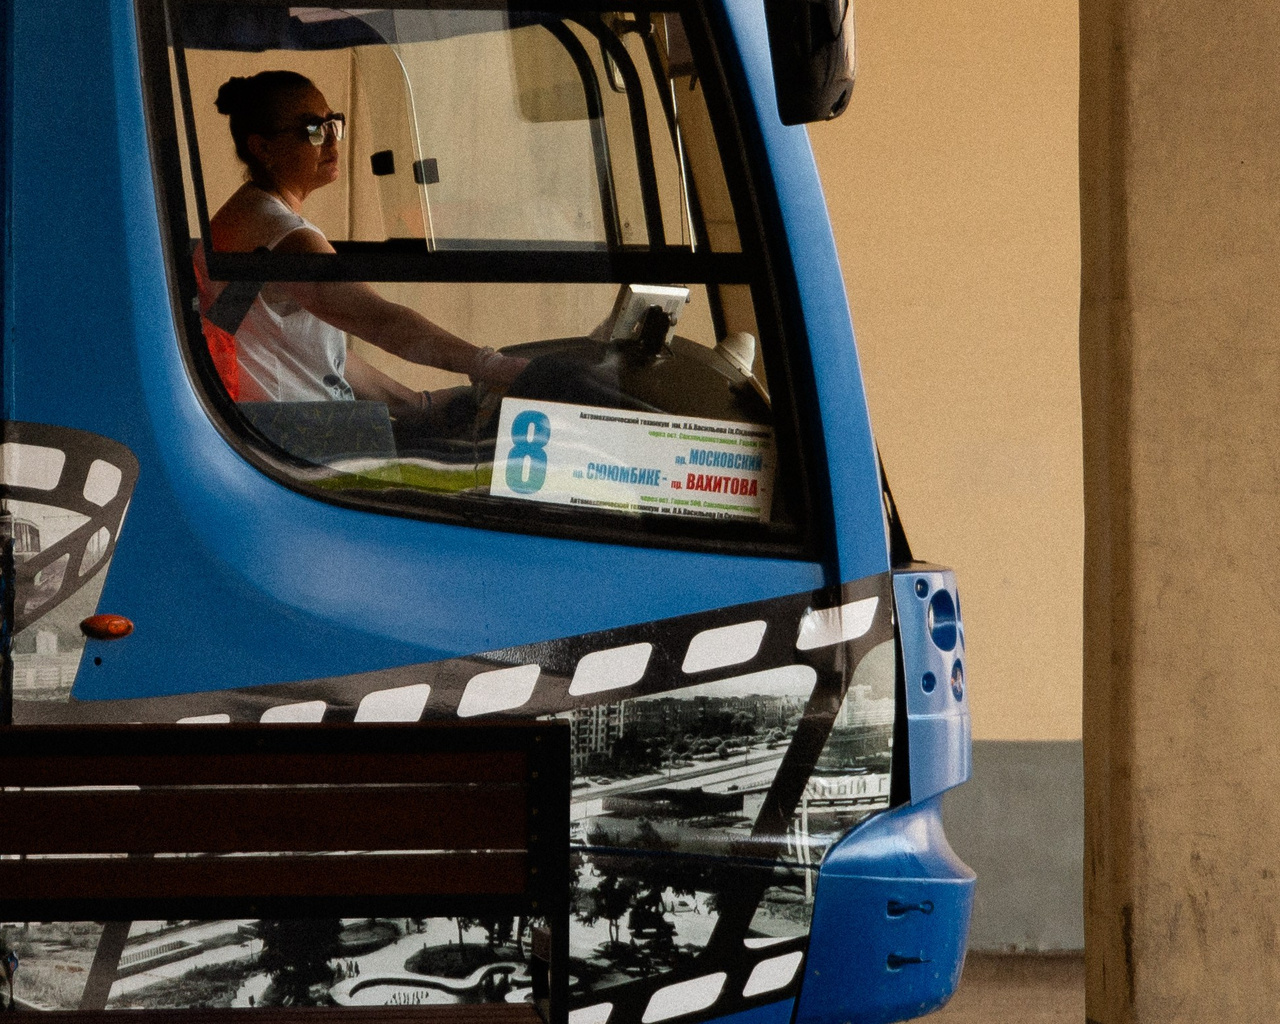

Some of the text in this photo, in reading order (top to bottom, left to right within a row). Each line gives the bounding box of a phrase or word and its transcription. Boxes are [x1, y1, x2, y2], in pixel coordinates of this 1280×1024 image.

[505, 409, 551, 495] 8
[674, 455, 687, 465] пр.
[688, 448, 762, 471] МОСКОВСКИЙ
[572, 470, 584, 479] пр.
[585, 462, 661, 486] СЮЮМБИКЕ
[670, 479, 682, 489] пр.
[685, 473, 758, 496] ВАХИТОВА
